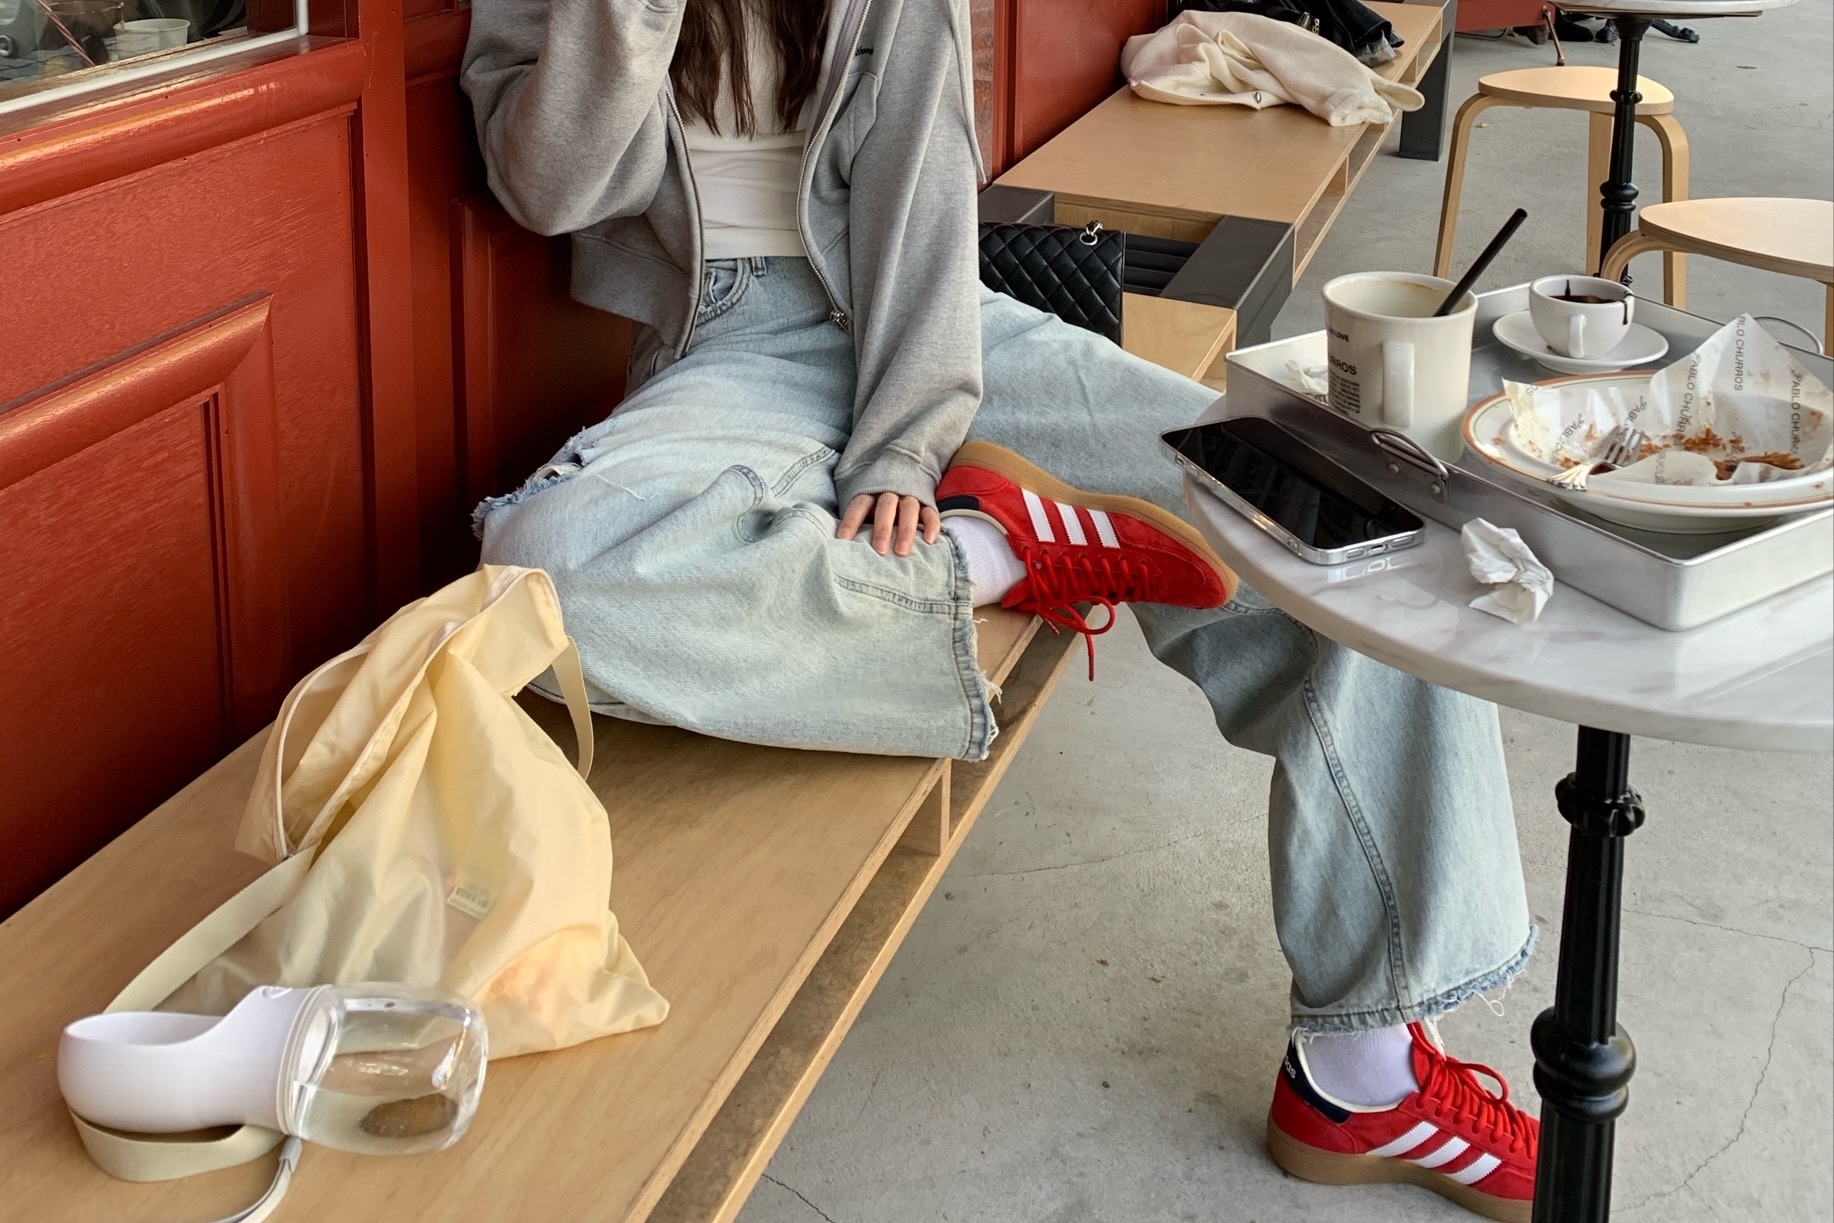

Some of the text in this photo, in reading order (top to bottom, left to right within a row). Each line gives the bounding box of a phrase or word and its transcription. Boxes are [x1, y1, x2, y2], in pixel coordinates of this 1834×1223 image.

[1734, 339, 1745, 392] CHURROS
[1791, 368, 1804, 411] PABLO
[1673, 393, 1694, 448] CHURRS
